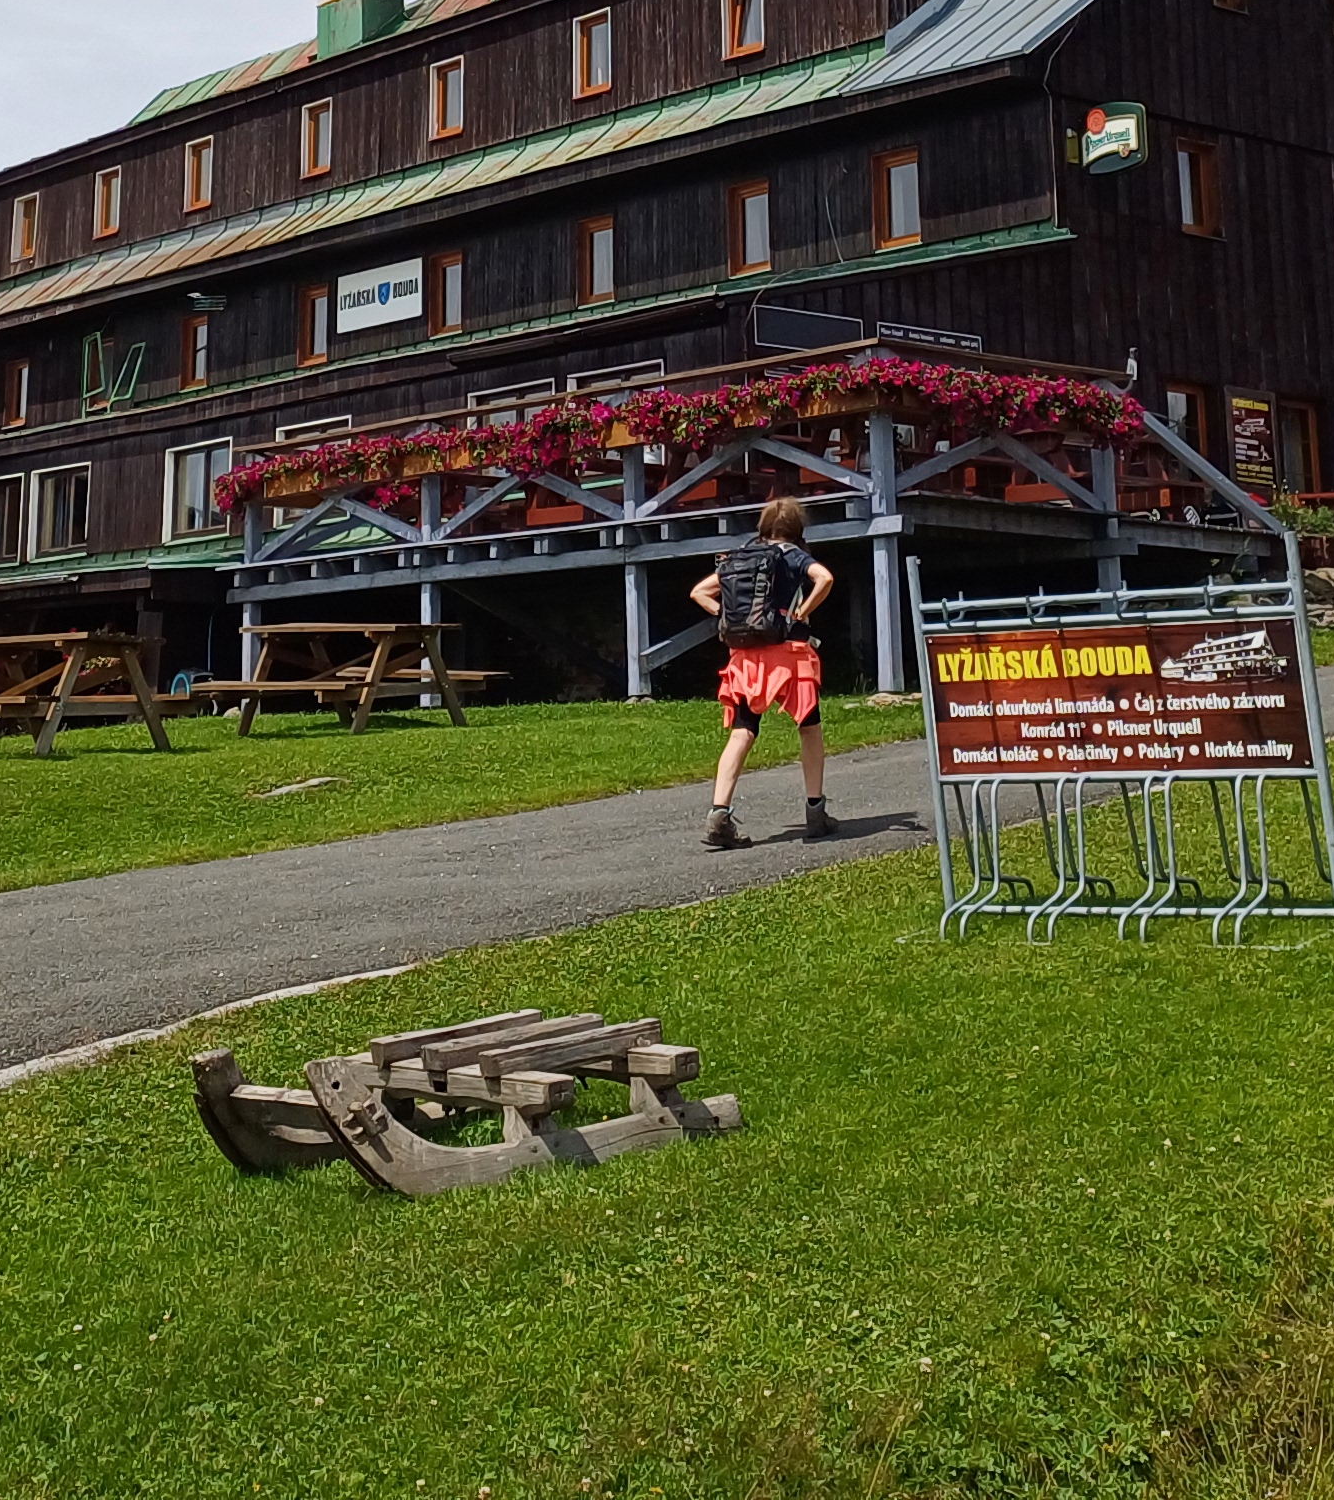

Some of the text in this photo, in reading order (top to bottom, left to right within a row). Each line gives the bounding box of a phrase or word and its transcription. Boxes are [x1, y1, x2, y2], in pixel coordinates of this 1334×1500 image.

[392, 277, 419, 299] BOUDA
[937, 643, 1153, 683] LYŽAŘSKÁ BOUDA
[949, 691, 1285, 717] Domácí okurková limonáda Čaj z čerstvého zázvoru
[1020, 721, 1066, 738] Konrád
[1107, 719, 1151, 737] Pilsner
[1153, 717, 1202, 738] Urquell
[953, 739, 1294, 764] Domácí koláče Palačinky Poháry Horké maliny
